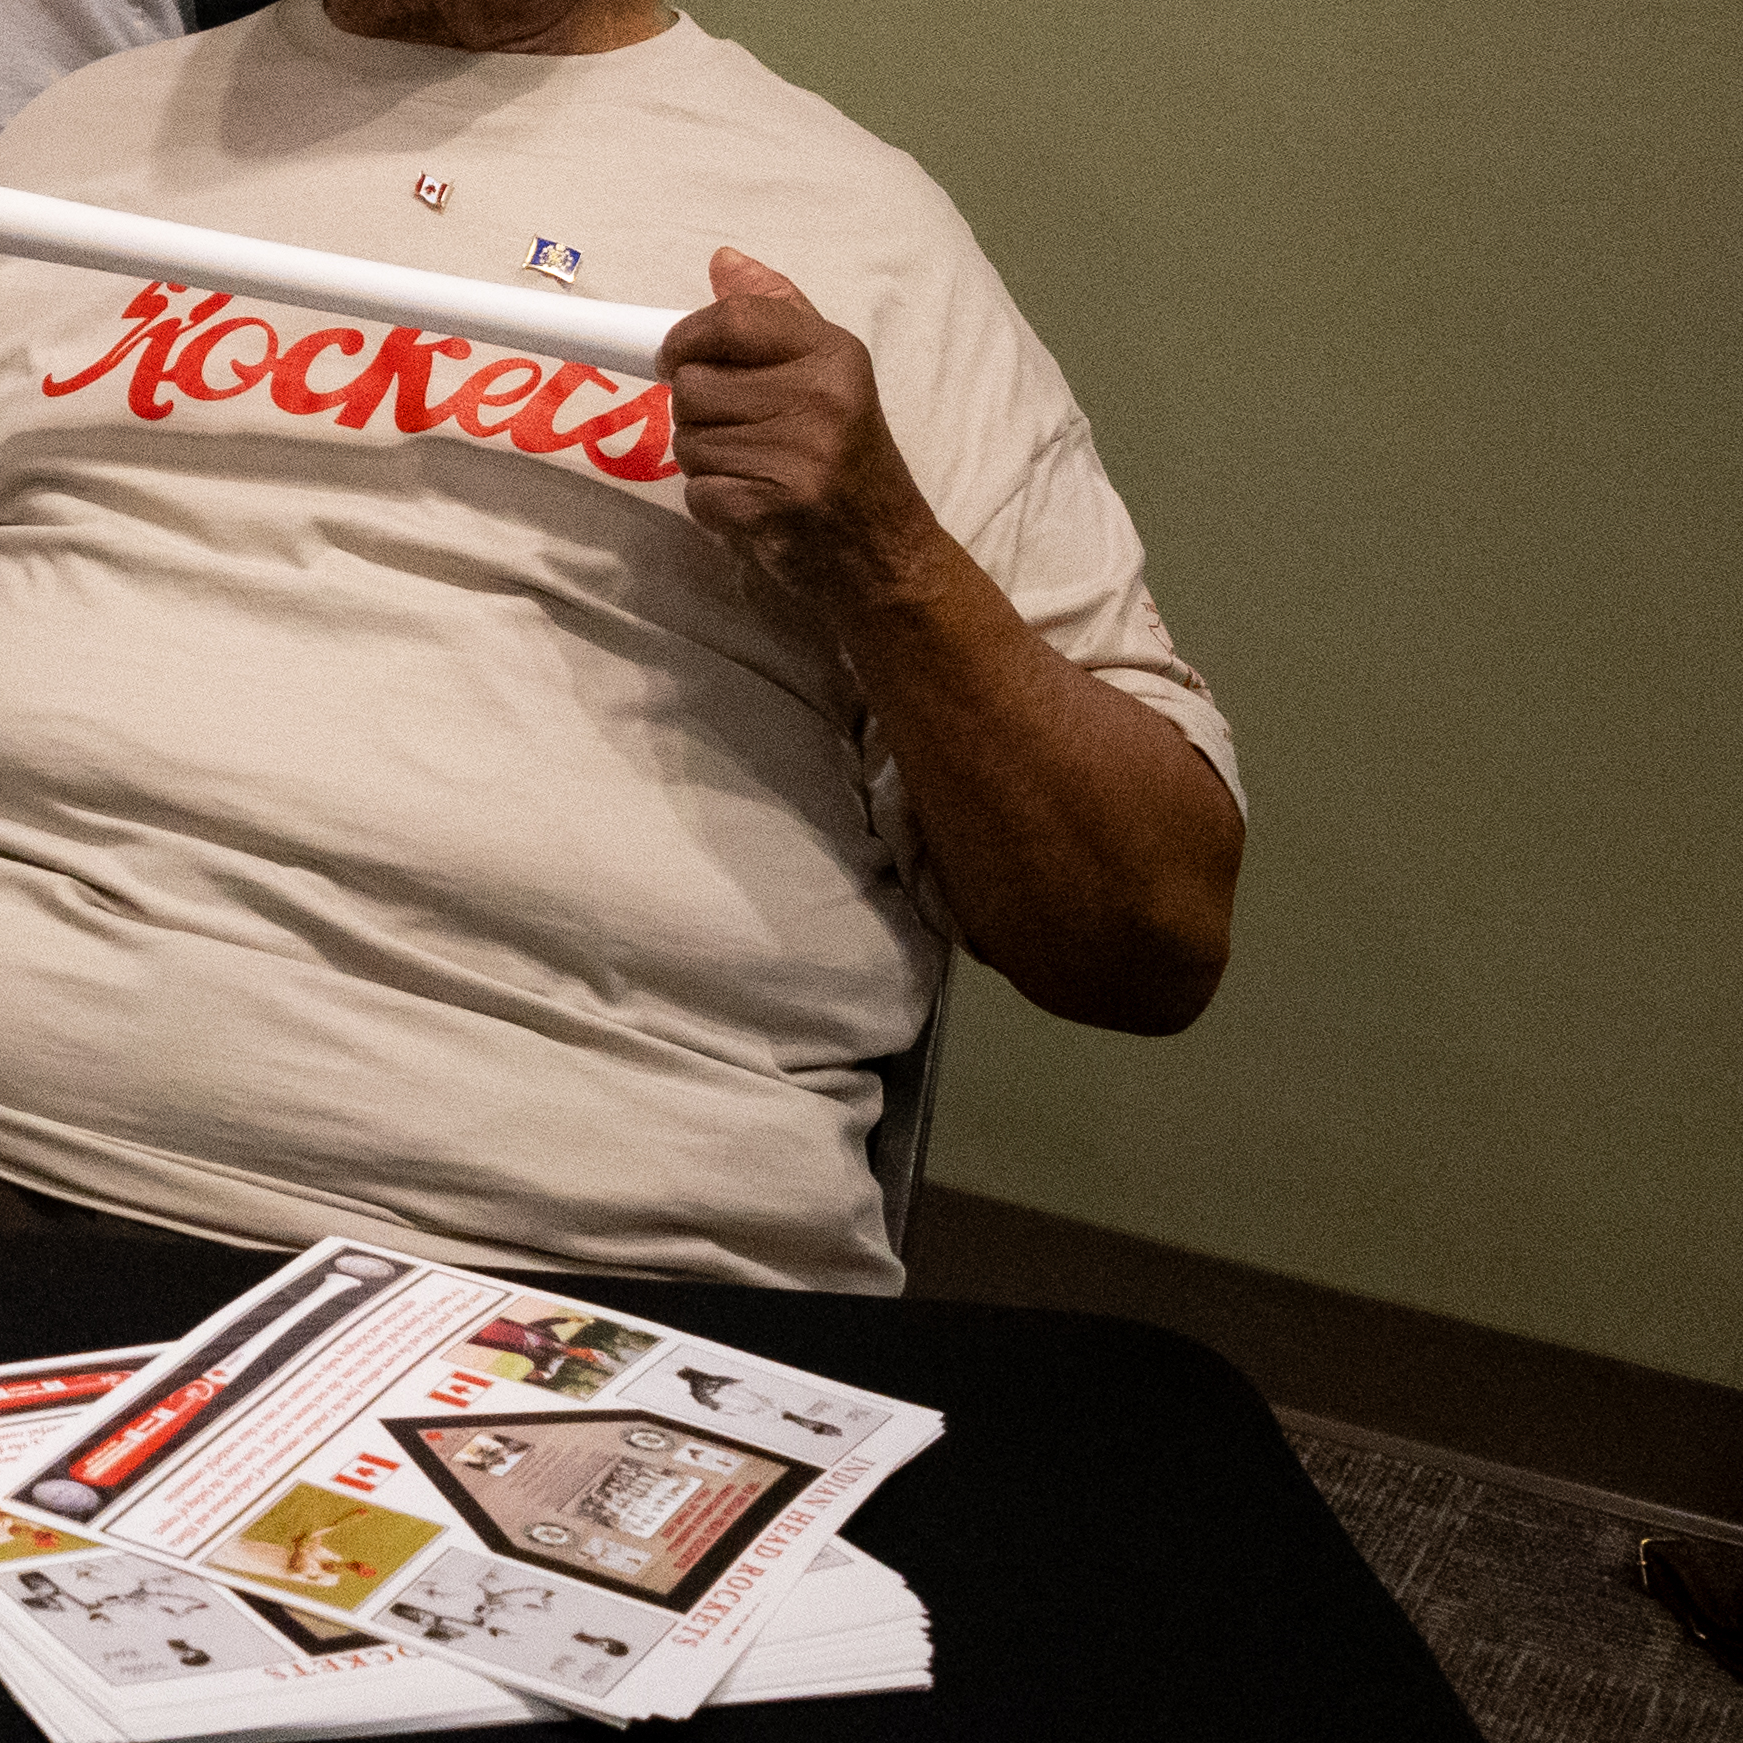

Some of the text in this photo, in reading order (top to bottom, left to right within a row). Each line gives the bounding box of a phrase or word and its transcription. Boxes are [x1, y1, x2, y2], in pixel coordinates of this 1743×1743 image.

[803, 1455, 876, 1509] INDIAN
[754, 1509, 816, 1559] HEAD
[672, 1562, 767, 1647] ROCKETS
